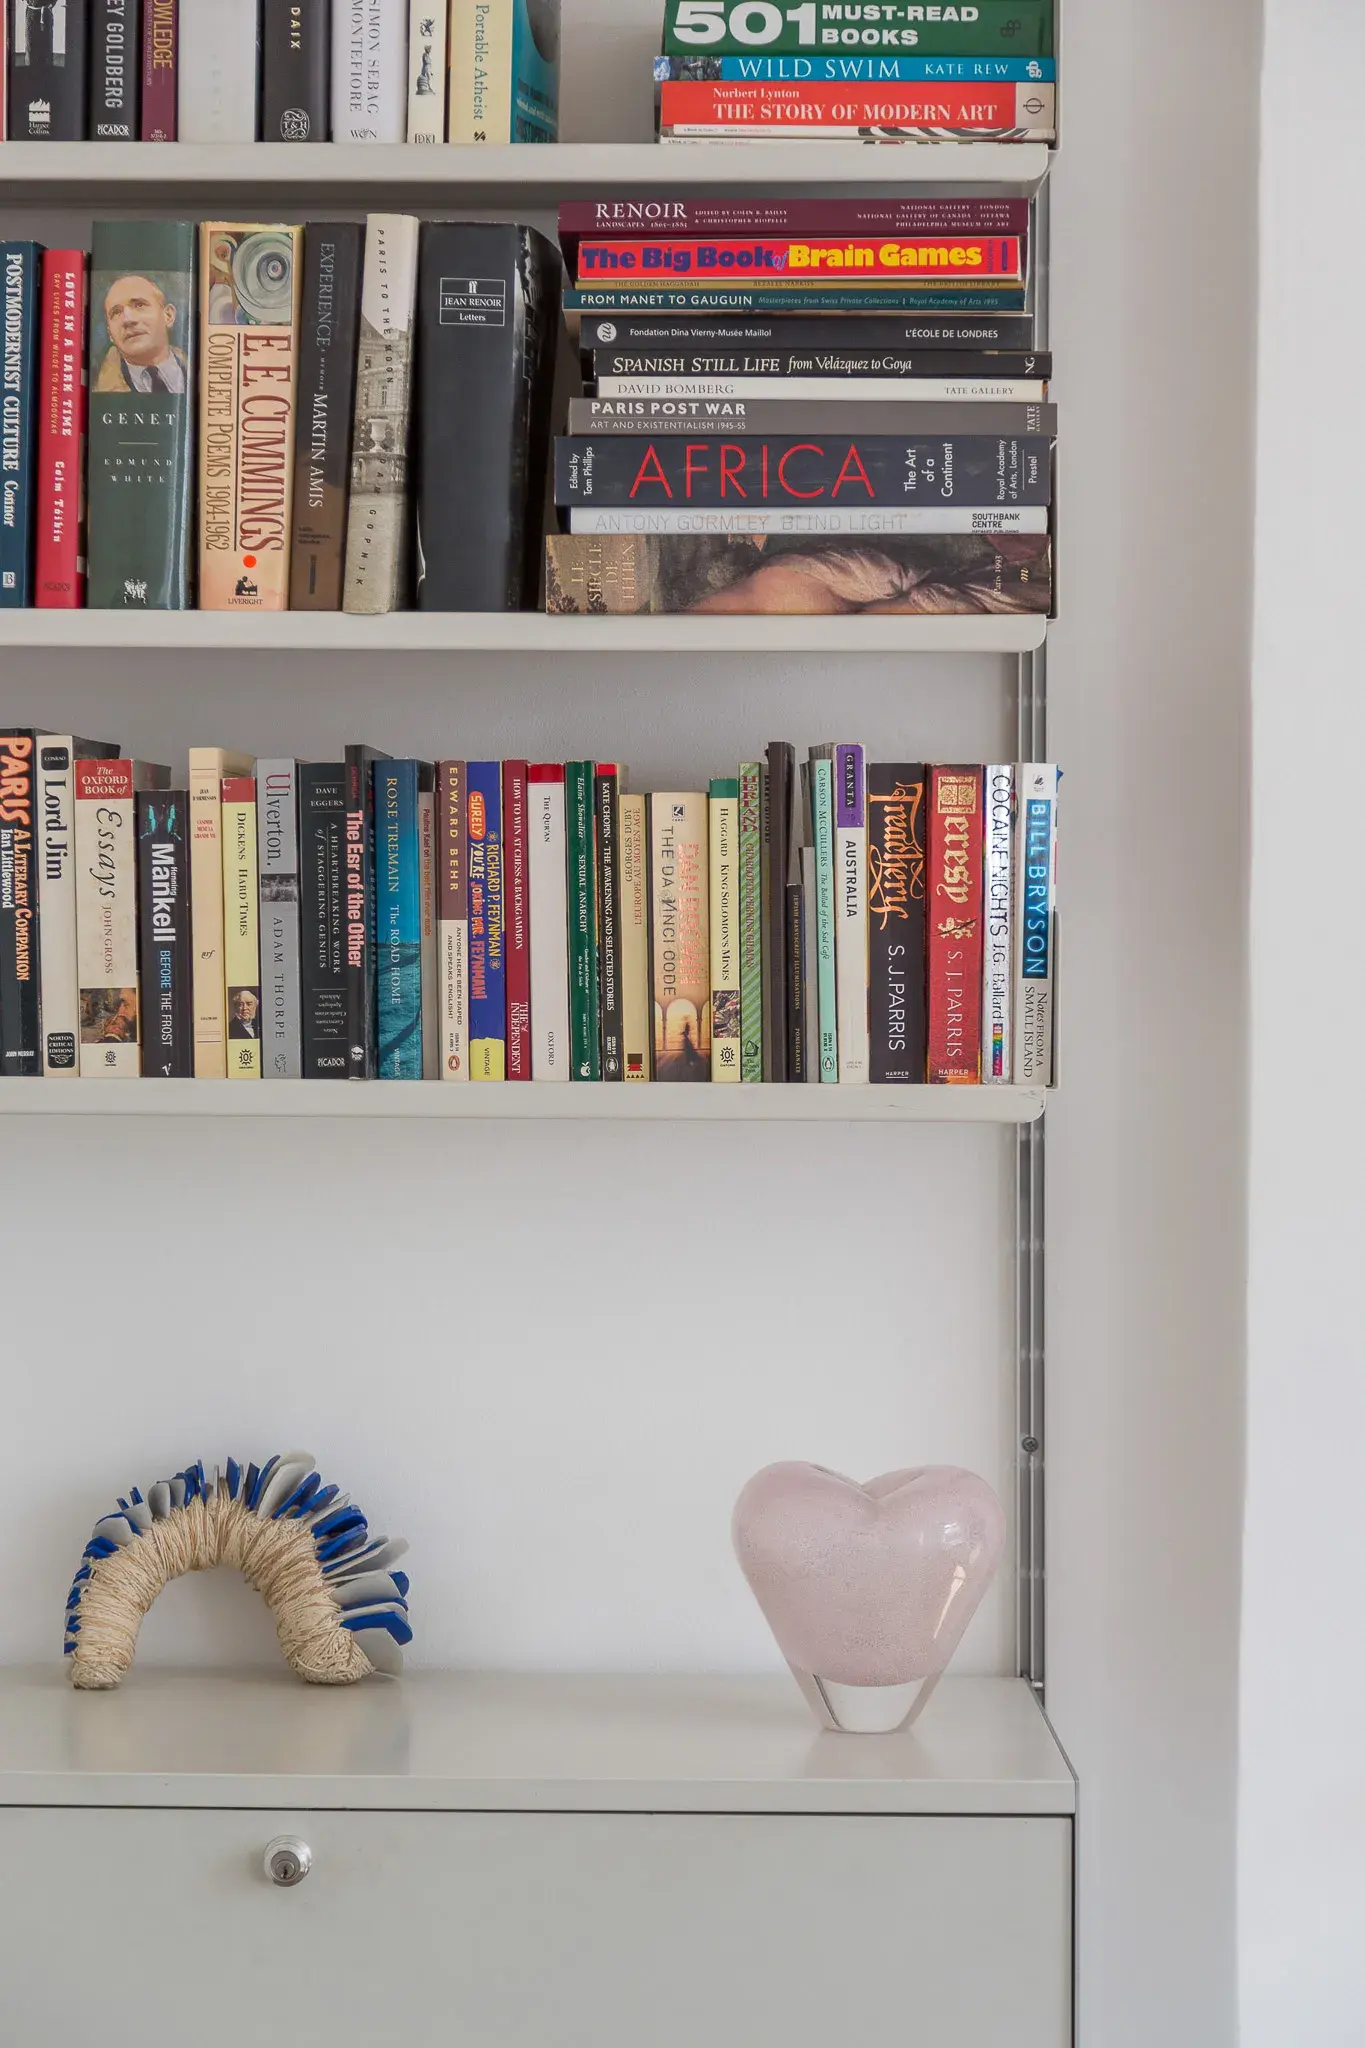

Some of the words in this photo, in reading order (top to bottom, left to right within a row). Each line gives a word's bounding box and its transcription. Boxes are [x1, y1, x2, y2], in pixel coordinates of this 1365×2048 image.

[290, 7, 302, 49] DAIX
[673, 1, 816, 46] 501
[822, 4, 980, 23] MUST-READ
[475, 4, 490, 63] Portable
[821, 27, 919, 46] BOOKS
[105, 22, 124, 108] GOLDBERG
[738, 58, 813, 78] WILD
[825, 58, 901, 78] SWIM
[925, 63, 965, 75] KATE
[974, 63, 1009, 75] REW
[367, 60, 379, 114] SEBAG
[474, 69, 487, 121] Atheist
[713, 87, 758, 99] Norbert
[760, 87, 800, 101] Lynton
[713, 103, 755, 120] THE
[760, 103, 826, 121] STORY
[831, 104, 859, 121] OF
[863, 104, 952, 121] MODERN
[957, 105, 998, 121] ART
[596, 203, 687, 218] RENOIR
[582, 247, 636, 268] The
[642, 246, 691, 272] Big
[697, 246, 774, 267] Book
[772, 250, 789, 271] of
[788, 244, 874, 268] Brain
[878, 243, 982, 267] Games
[64, 272, 76, 308] LOVE
[316, 242, 335, 346] EXPERIENCE
[444, 297, 467, 306] JEAN
[469, 298, 502, 307] RENOIR
[581, 295, 615, 305] FROM
[620, 294, 664, 305] MANET
[668, 294, 687, 305] TO
[690, 294, 752, 305] GAUGUIN
[3, 253, 23, 391] POSTMODERNIST
[64, 314, 75, 331] IN
[459, 312, 486, 321] Letters
[629, 328, 669, 336] Fondation
[671, 328, 689, 336] Dina
[690, 328, 743, 338] Vierny-Musée
[745, 328, 772, 337] Maillol
[942, 329, 954, 338] DE
[957, 329, 998, 338] LONDRES
[63, 338, 73, 347] A
[243, 333, 291, 357] E.
[62, 354, 74, 392] DARK
[206, 333, 235, 417] COMPLETE
[242, 364, 290, 387] E.
[612, 357, 685, 373] SPANISH
[691, 357, 740, 372] STILL
[743, 357, 780, 372] LIFE
[786, 356, 813, 374] from
[815, 356, 869, 374] Velázquez
[871, 357, 881, 370] to
[882, 356, 912, 373] Goya
[617, 384, 661, 394] DAVID
[665, 384, 734, 394] BOMBERG
[945, 387, 968, 395] TATE
[971, 387, 1015, 395] GALLERY
[61, 399, 73, 437] TIME
[102, 413, 176, 425] GENET
[590, 420, 610, 429] ART
[612, 420, 634, 429] AND
[637, 420, 714, 429] EXISTENTIALISM
[591, 402, 645, 415] PARIS
[651, 402, 699, 414] POST
[705, 402, 746, 415] WAR
[3, 396, 20, 471] CULTURE
[311, 393, 329, 460] MARTIN
[206, 423, 234, 478] POEMS
[569, 453, 580, 464] by
[582, 446, 594, 476] Phillips
[904, 449, 916, 468] Art
[927, 458, 935, 467] a
[54, 461, 65, 491] Colm
[308, 465, 325, 508] AMIS
[569, 465, 578, 489] Edited
[584, 478, 593, 496] Tom
[628, 443, 875, 498] AFRICA
[904, 471, 916, 491] The
[921, 469, 935, 482] of
[941, 443, 953, 497] Continent
[1028, 456, 1038, 484] Prestel
[3, 480, 19, 527] Connor
[53, 498, 65, 543] Tóibín
[205, 485, 232, 551] 1904-1962
[972, 512, 1020, 521] SOUTHBANK
[972, 520, 1002, 529] CENTRE
[356, 509, 377, 586] GOPNIK
[0, 736, 33, 826] PARIS
[602, 783, 611, 804] KATE
[44, 779, 68, 831] Lord
[385, 778, 399, 820] ROSE
[449, 767, 460, 839] EDWARD
[470, 795, 483, 836] SURELY
[1, 829, 13, 848] Ian
[14, 828, 30, 841] A
[602, 805, 612, 838] CHOPIN
[1030, 804, 1046, 857] BILL
[46, 837, 69, 880] Jim
[88, 807, 123, 899] Essays
[386, 822, 399, 893] TREMAIN
[450, 848, 460, 891] BEHR
[486, 844, 500, 891] RICHARD
[1, 850, 14, 909] Littlewood
[577, 855, 586, 888] SEXUAL
[845, 839, 858, 918] AUSTRALIA
[151, 843, 176, 942] Mankell
[990, 865, 1009, 937] NIGHTS
[389, 905, 400, 924] The
[578, 891, 587, 933] ANARCHY
[1026, 866, 1047, 974] BRYSON
[273, 917, 284, 963] ADAM
[389, 928, 401, 963] ROAD
[488, 904, 502, 956] FEYNMAN
[160, 950, 172, 989] BEFORE
[946, 950, 963, 964] S.
[390, 966, 401, 1005] HOME
[946, 971, 962, 981] J.
[161, 991, 172, 1011] THE
[274, 974, 285, 1039] THORPE
[990, 974, 1004, 1019] Ballard
[1024, 986, 1035, 1028] SMALL
[1037, 992, 1048, 1024] Notes
[161, 1014, 172, 1047] FROST
[946, 988, 963, 1057] PARRIS
[1036, 1025, 1045, 1049] FROM
[547, 1031, 555, 1065] OXFORD
[1023, 1031, 1035, 1078] ISLAND
[1036, 1059, 1045, 1067] A
